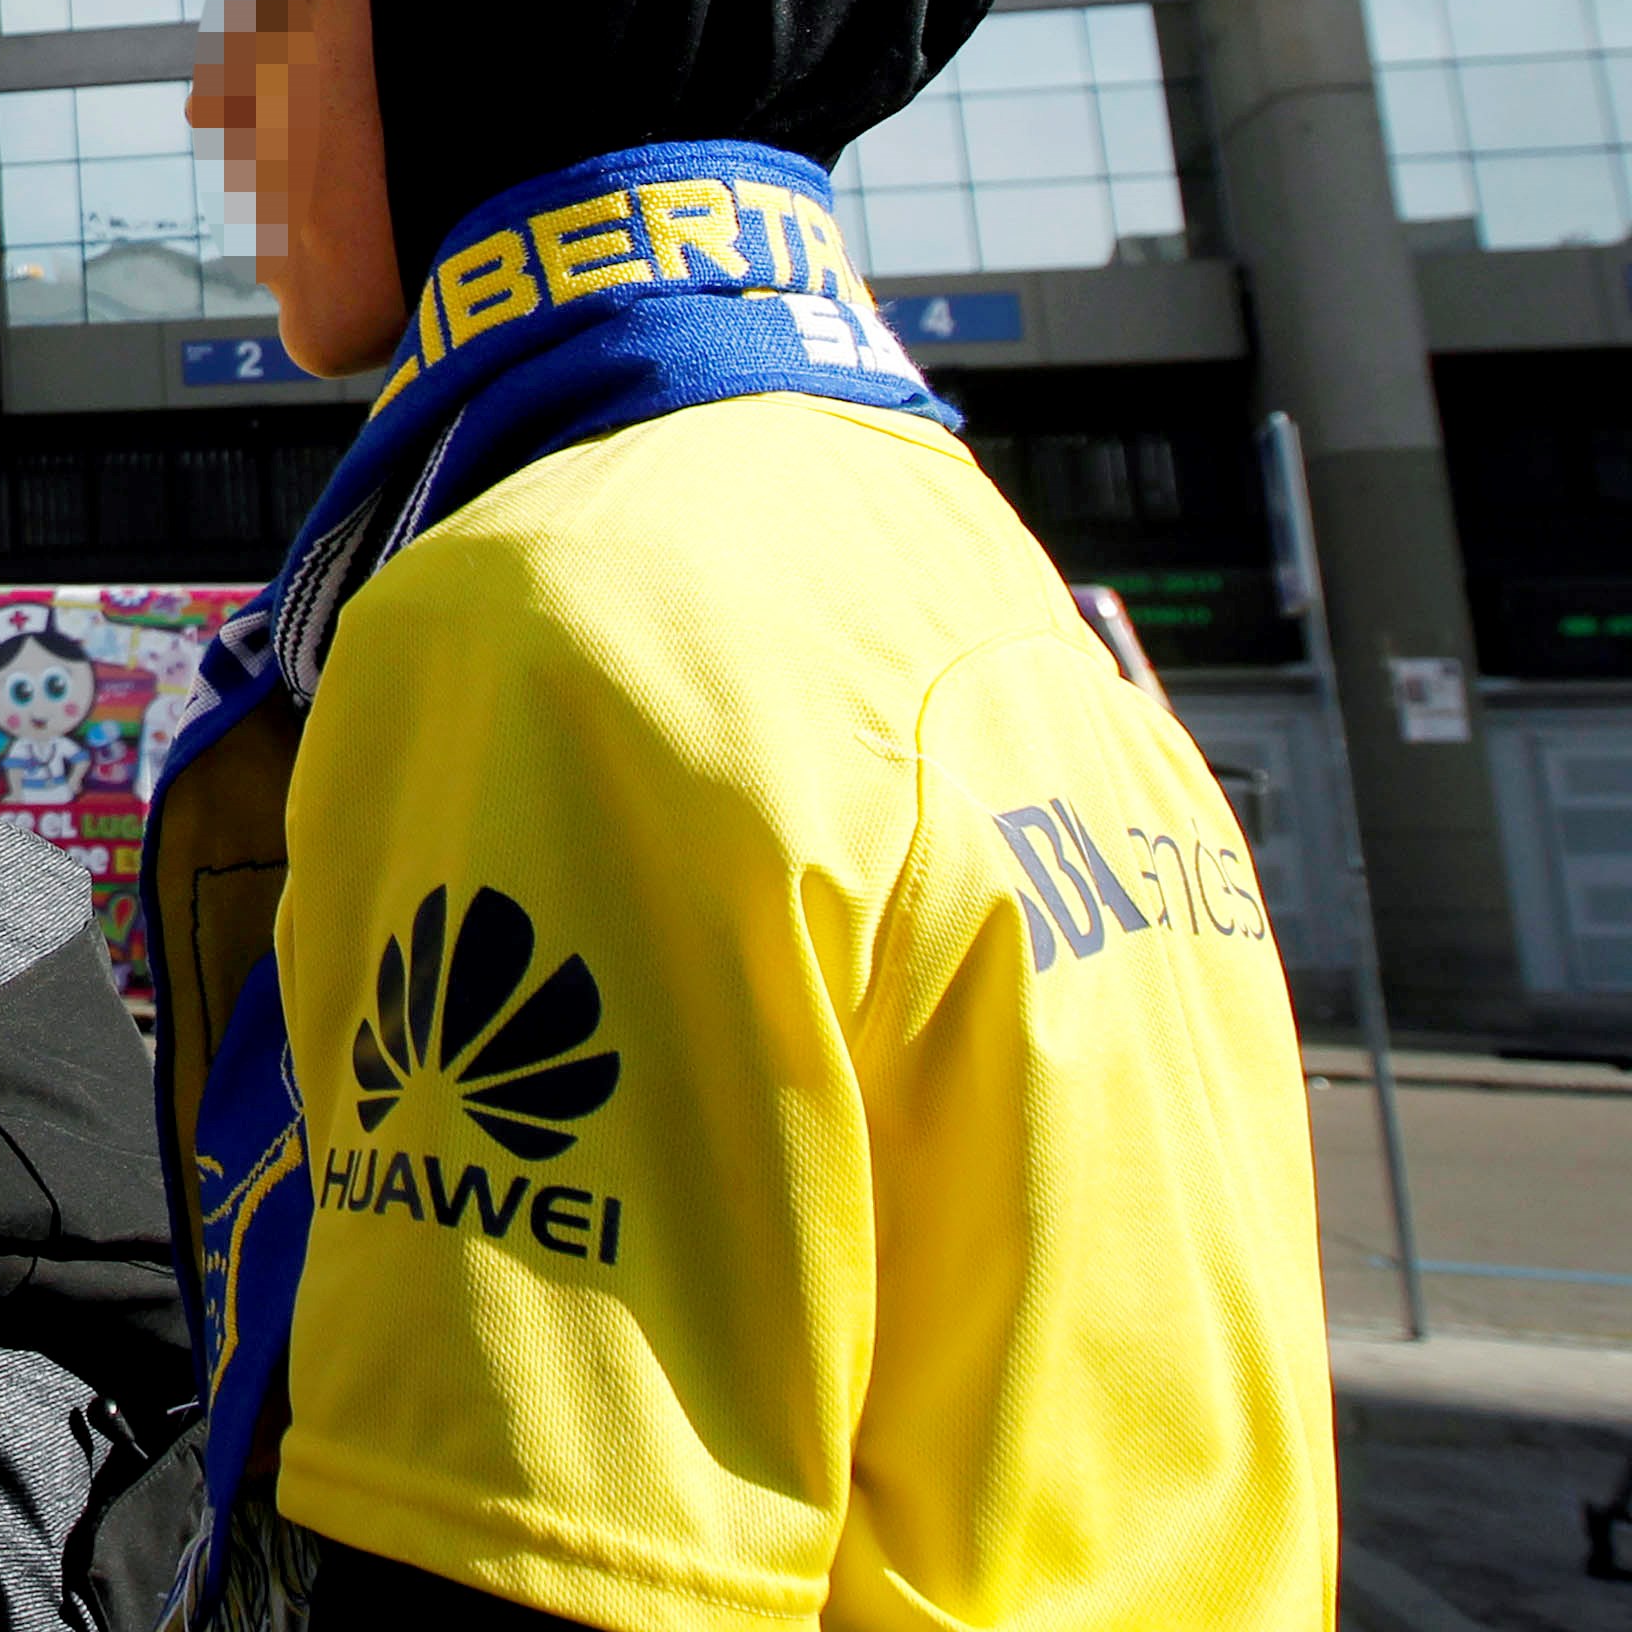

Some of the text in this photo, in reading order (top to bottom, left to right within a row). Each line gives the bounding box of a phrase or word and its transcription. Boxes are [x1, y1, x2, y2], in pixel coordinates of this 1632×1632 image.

[919, 297, 955, 338] 4
[237, 340, 264, 378] 2
[320, 1148, 622, 1265] HUAWEI
